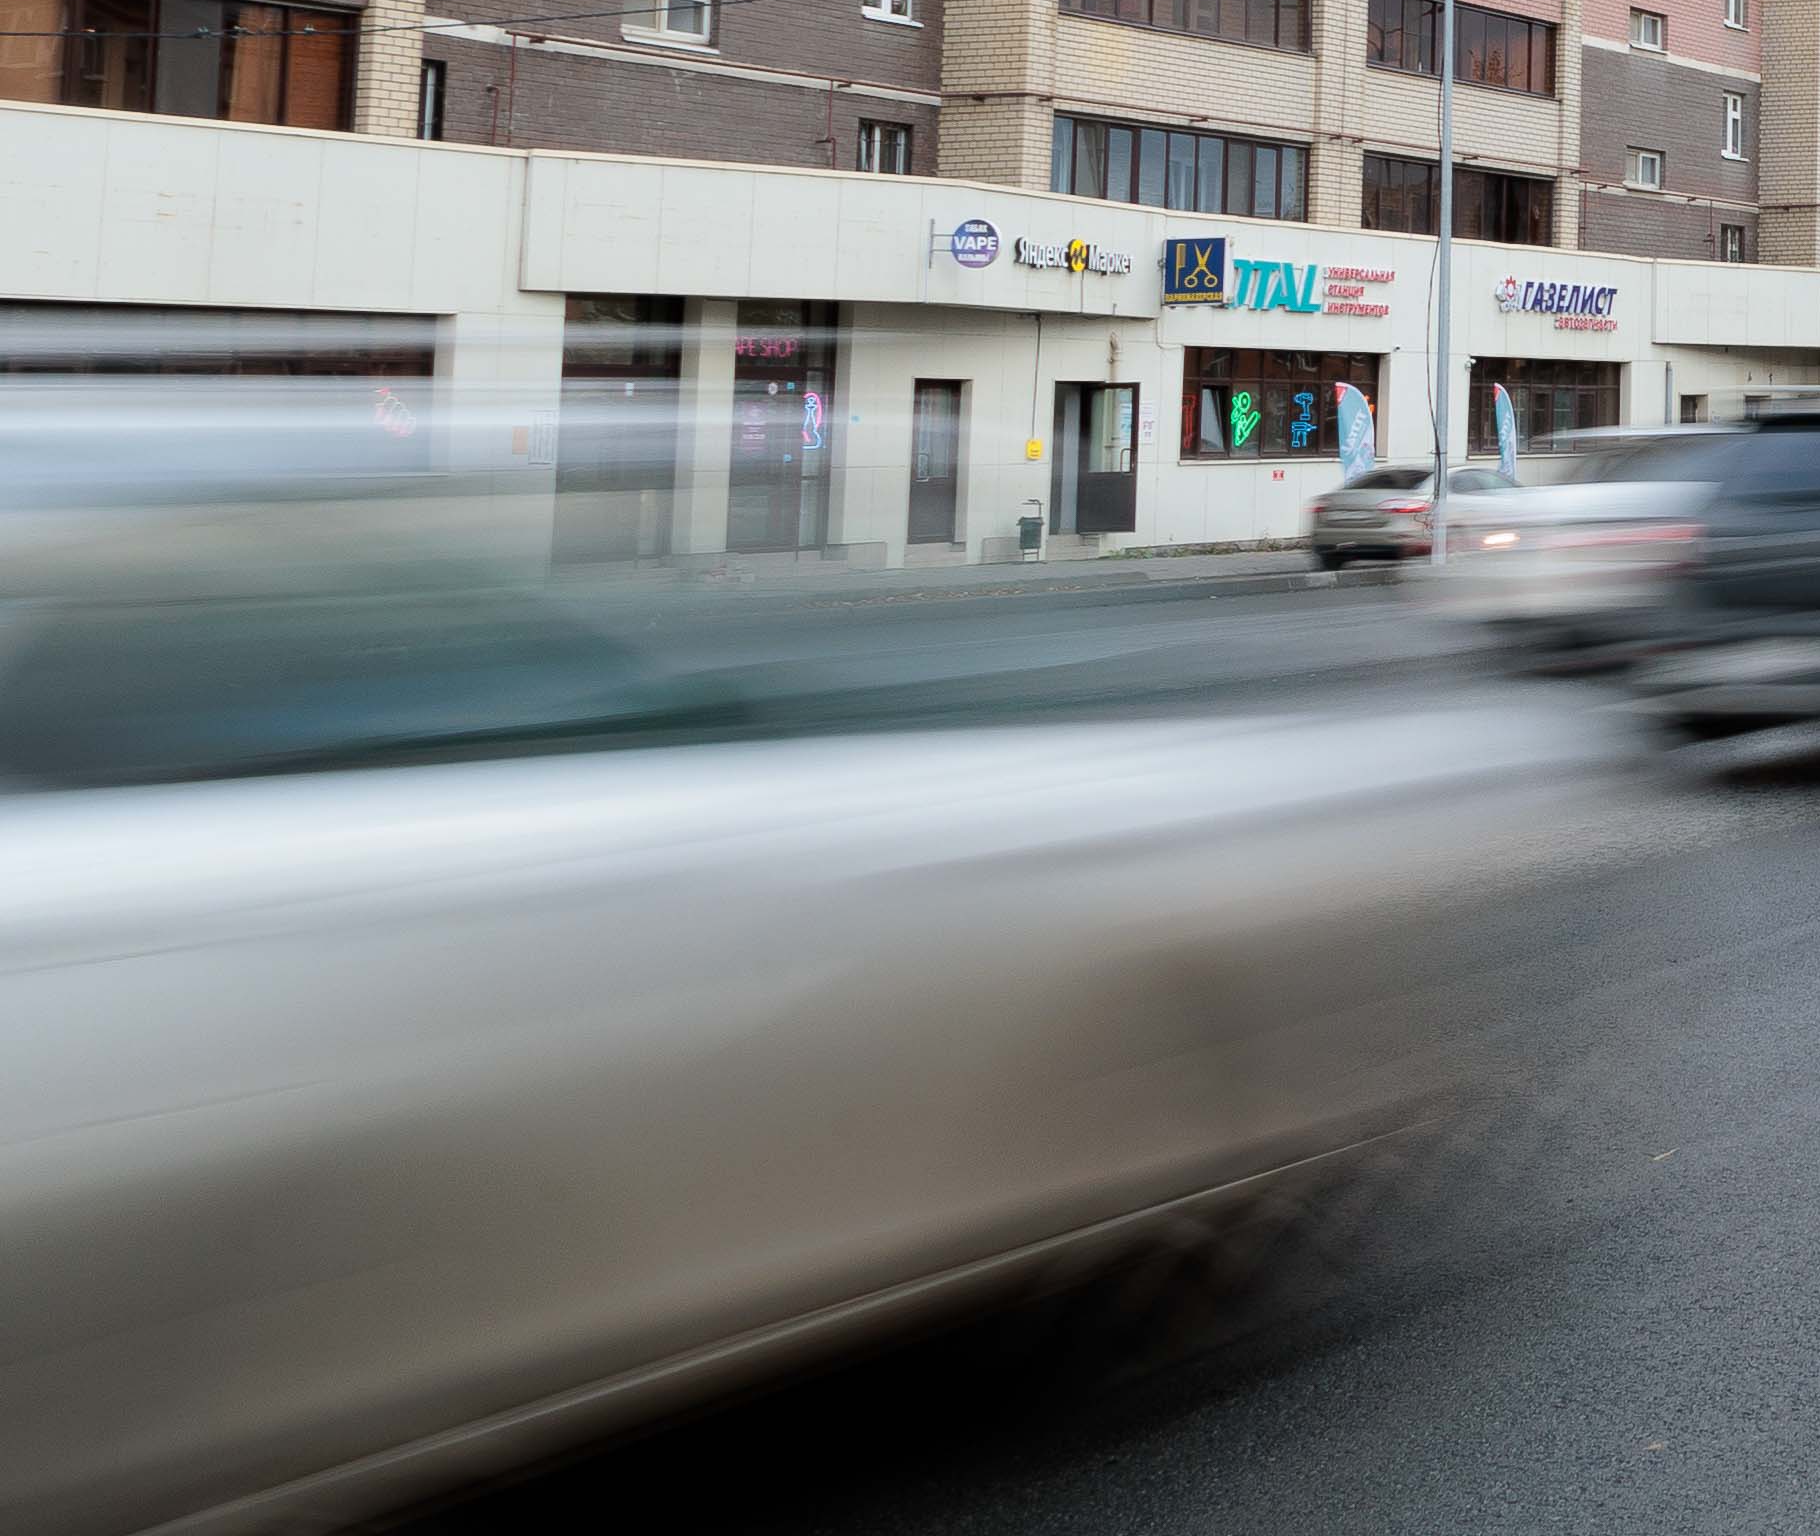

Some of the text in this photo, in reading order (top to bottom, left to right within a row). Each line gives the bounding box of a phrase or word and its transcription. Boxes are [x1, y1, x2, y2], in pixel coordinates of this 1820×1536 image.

[953, 235, 998, 251] VAPE
[1018, 237, 1134, 276] Яндекс Маркет
[1328, 266, 1396, 281] УНИВЕРСАЛЬНАЯ
[1228, 259, 1322, 313] TAL
[1327, 284, 1365, 297] СТАНЦИЯ
[1522, 281, 1618, 316] ГАЗЕЛИСТ
[1327, 302, 1390, 315] ИНСТРУМЕНТОВ
[760, 336, 799, 357] SHOP
